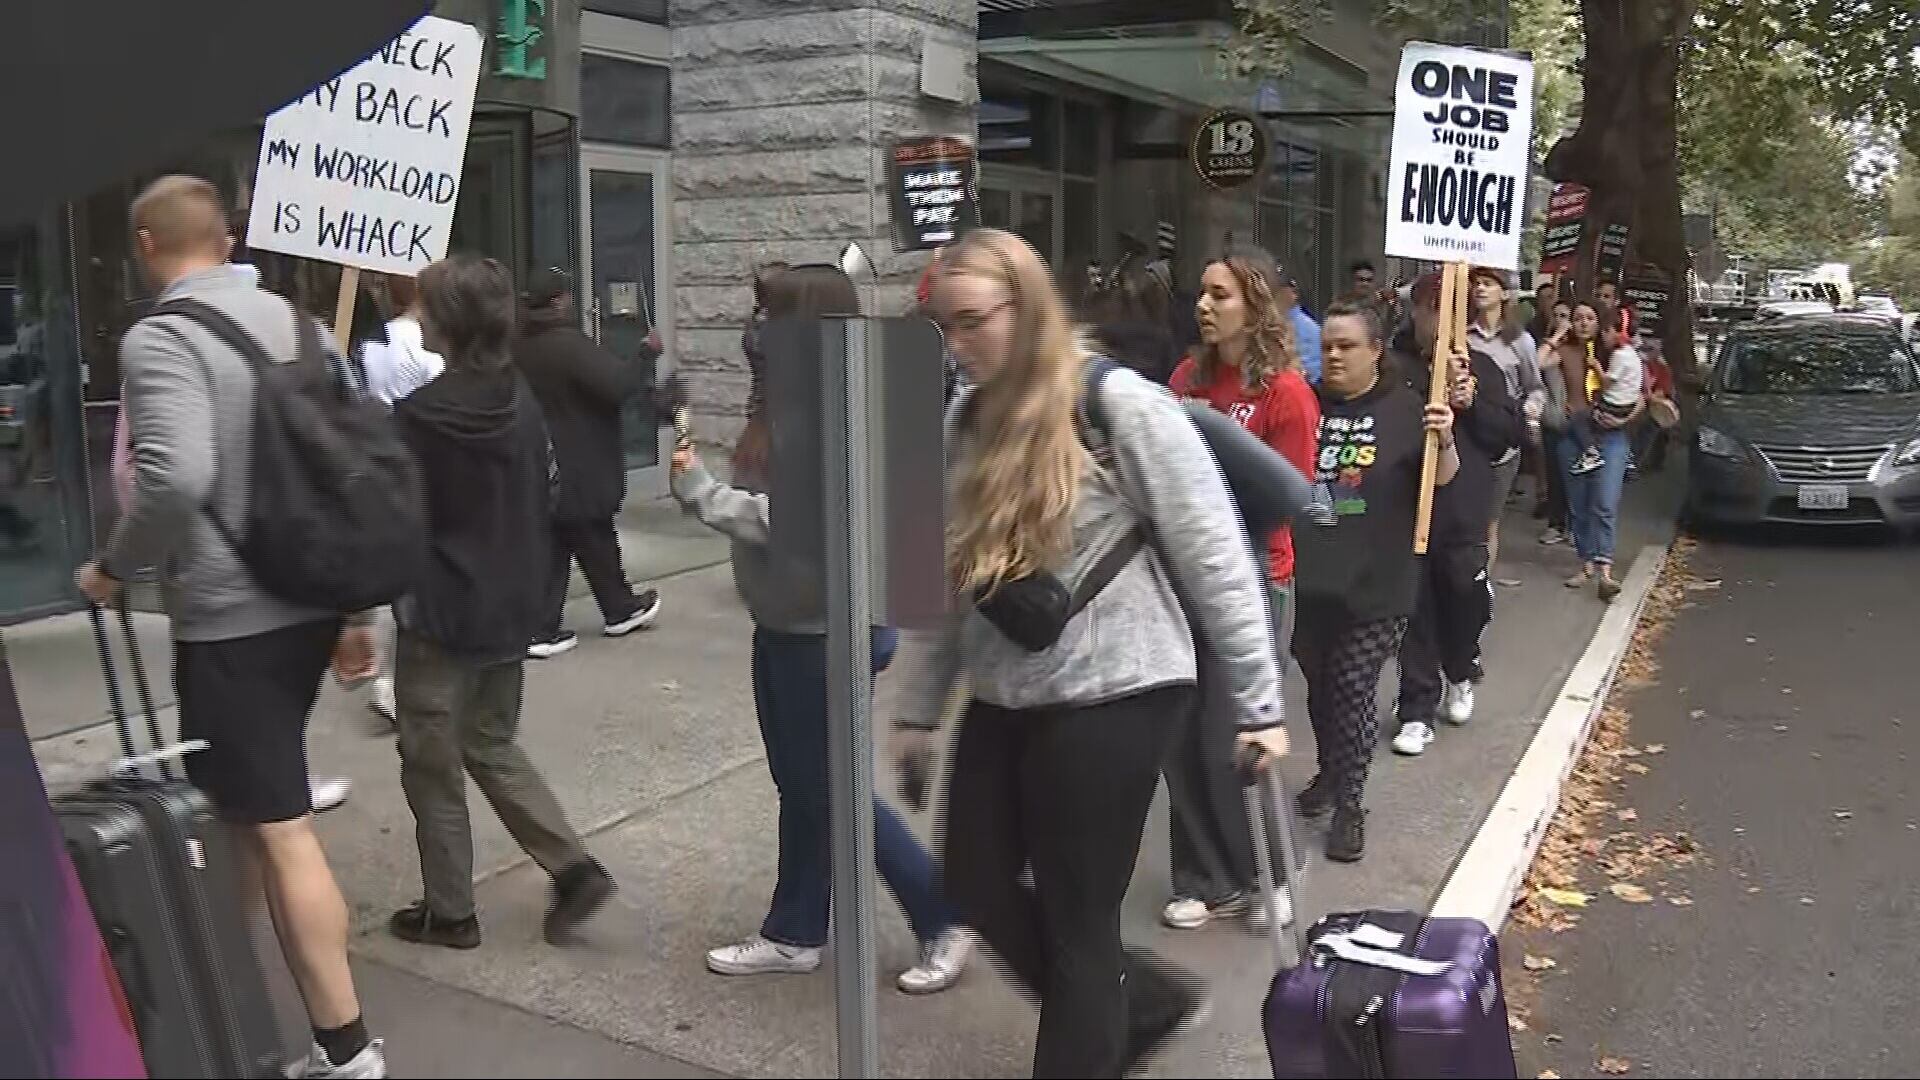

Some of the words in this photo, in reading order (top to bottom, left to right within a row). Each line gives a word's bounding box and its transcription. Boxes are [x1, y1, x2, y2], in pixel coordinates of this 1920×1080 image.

[1410, 60, 1519, 109] ONE
[355, 81, 452, 139] BACK
[1422, 102, 1510, 134] JOB
[1432, 128, 1500, 151] SHOULD
[1207, 154, 1254, 169] COINS
[1454, 149, 1476, 166] BE
[267, 139, 301, 169] MY
[313, 143, 456, 205] WORKLOAD
[904, 171, 962, 190] MAKE
[904, 188, 964, 207] THEM
[1400, 161, 1516, 236] ENOUGH
[912, 206, 959, 226] PAY.
[273, 201, 301, 234] IS
[317, 205, 433, 263] WHACK
